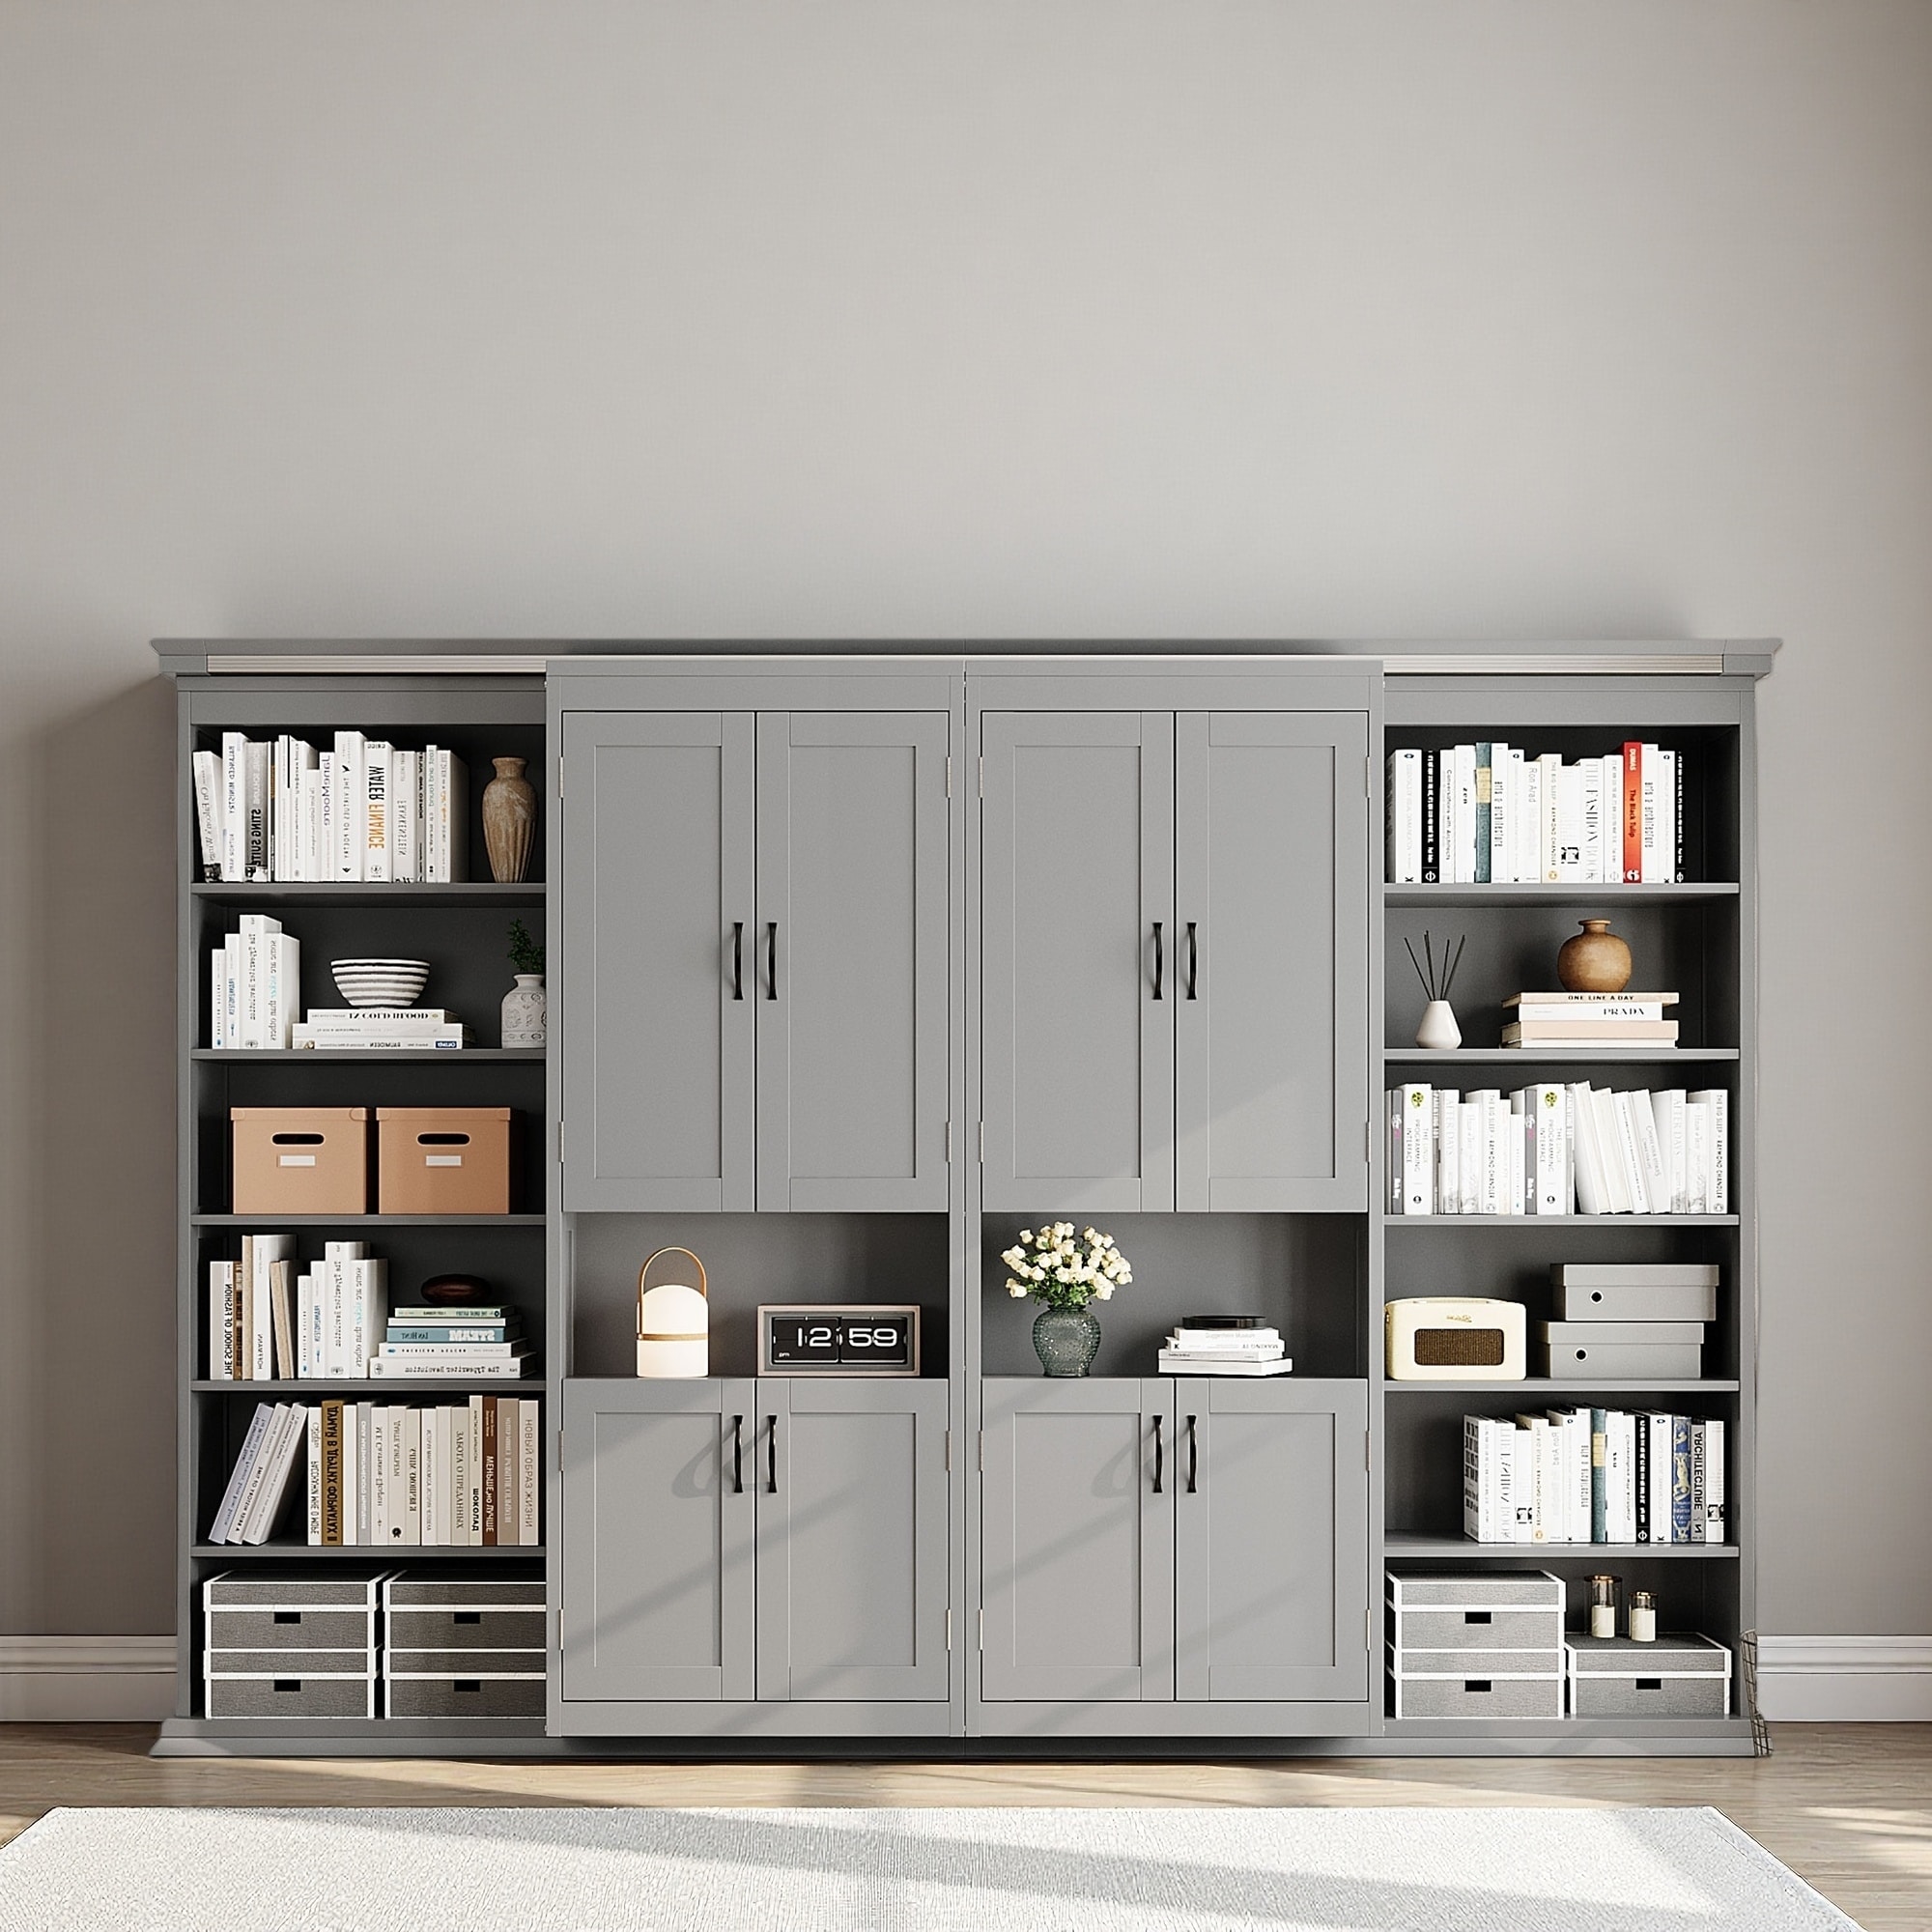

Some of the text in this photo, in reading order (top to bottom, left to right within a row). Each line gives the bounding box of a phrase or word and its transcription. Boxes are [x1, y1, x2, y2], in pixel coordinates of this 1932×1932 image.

[1528, 767, 1538, 783] Ron
[1528, 784, 1538, 803] Arad
[1586, 790, 1598, 842] FASHION
[1628, 821, 1636, 838] Tulip
[848, 1327, 898, 1348] 59
[525, 1419, 534, 1527] НОВЫЙ ОБРАЗ ЖИЗНИ
[455, 1474, 464, 1529] ПРЕДАННЫХ
[486, 1504, 495, 1533] ЛУЧШЕ
